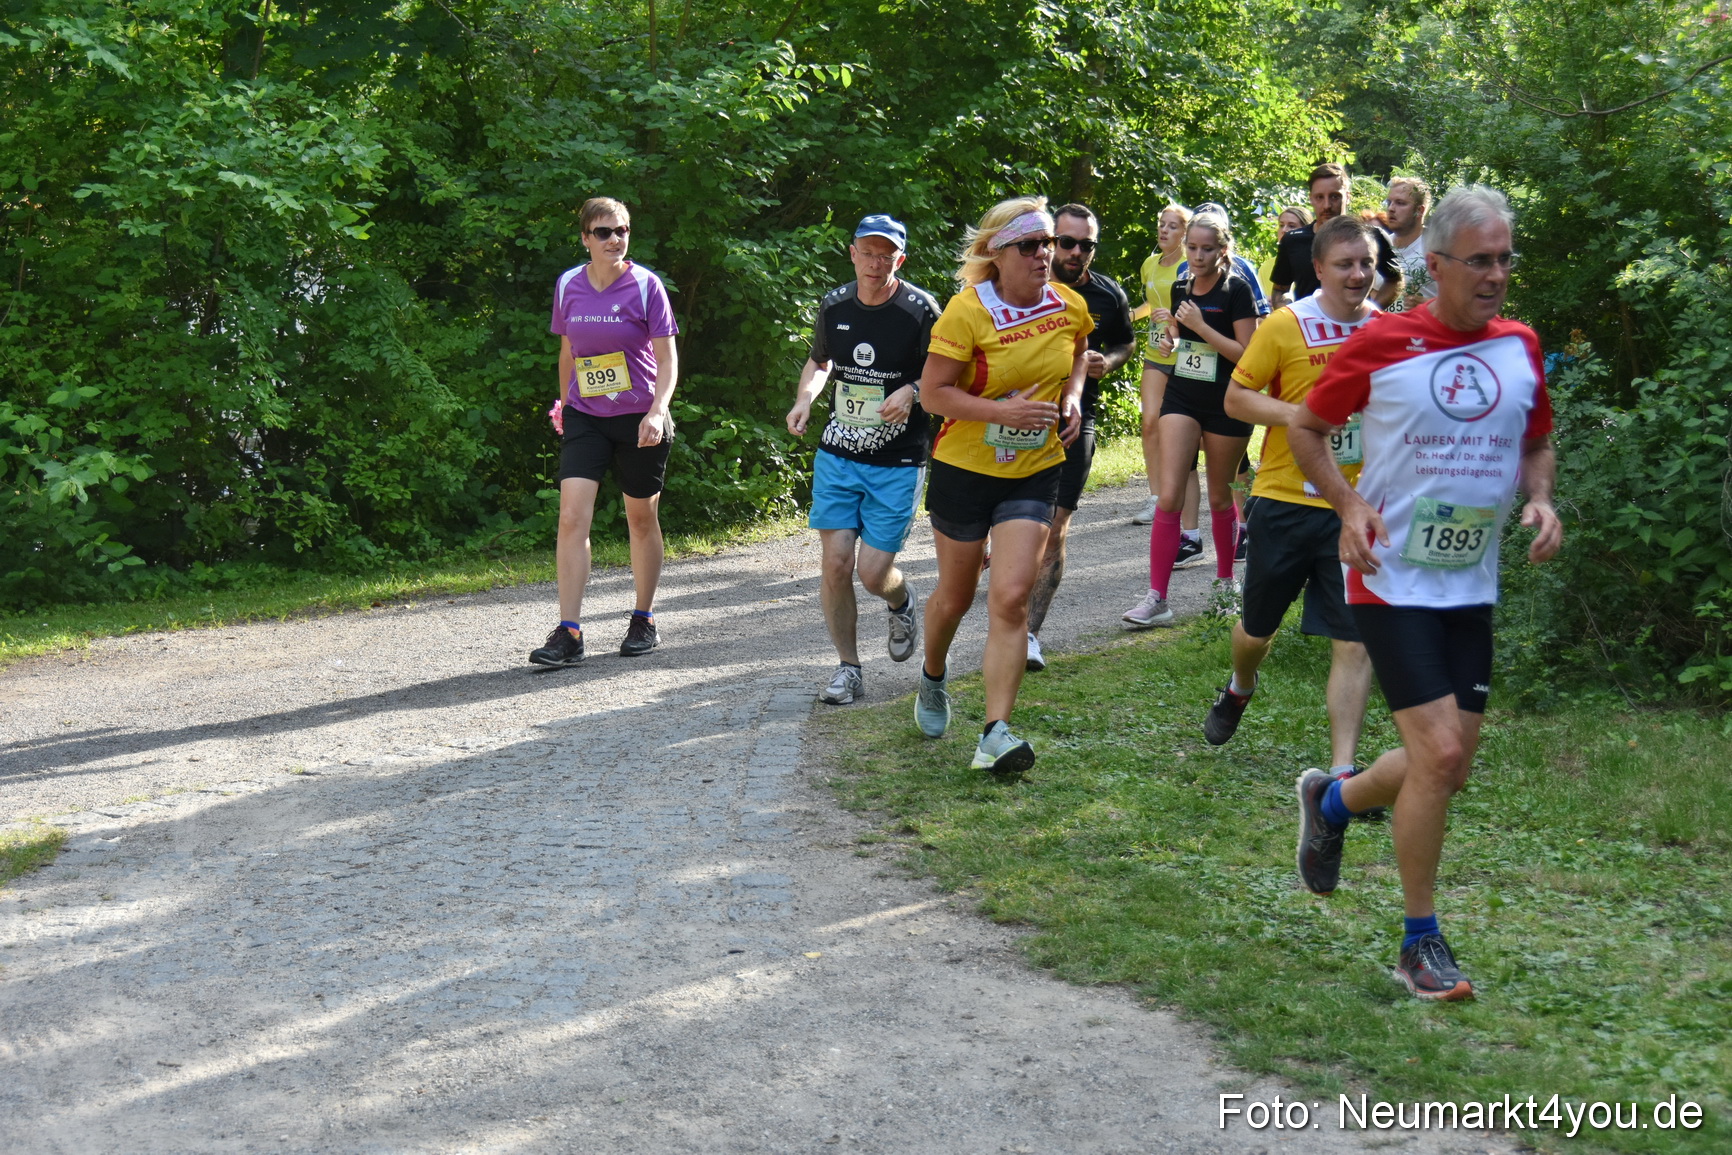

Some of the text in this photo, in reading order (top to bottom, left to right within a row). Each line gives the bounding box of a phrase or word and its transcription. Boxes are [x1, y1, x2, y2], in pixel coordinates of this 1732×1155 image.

[1385, 300, 1403, 312] 85
[999, 328, 1034, 346] MAX
[1036, 316, 1071, 335] BÖGL
[1186, 354, 1201, 369] 43
[586, 368, 616, 386] 899
[844, 372, 884, 385] SCHOTTERWERKE
[846, 399, 865, 416] 97
[1416, 452, 1429, 460] Dr.
[1432, 452, 1456, 460] Heck
[1416, 466, 1502, 478] Leistungsdiagnostik
[1422, 524, 1484, 551] 1893
